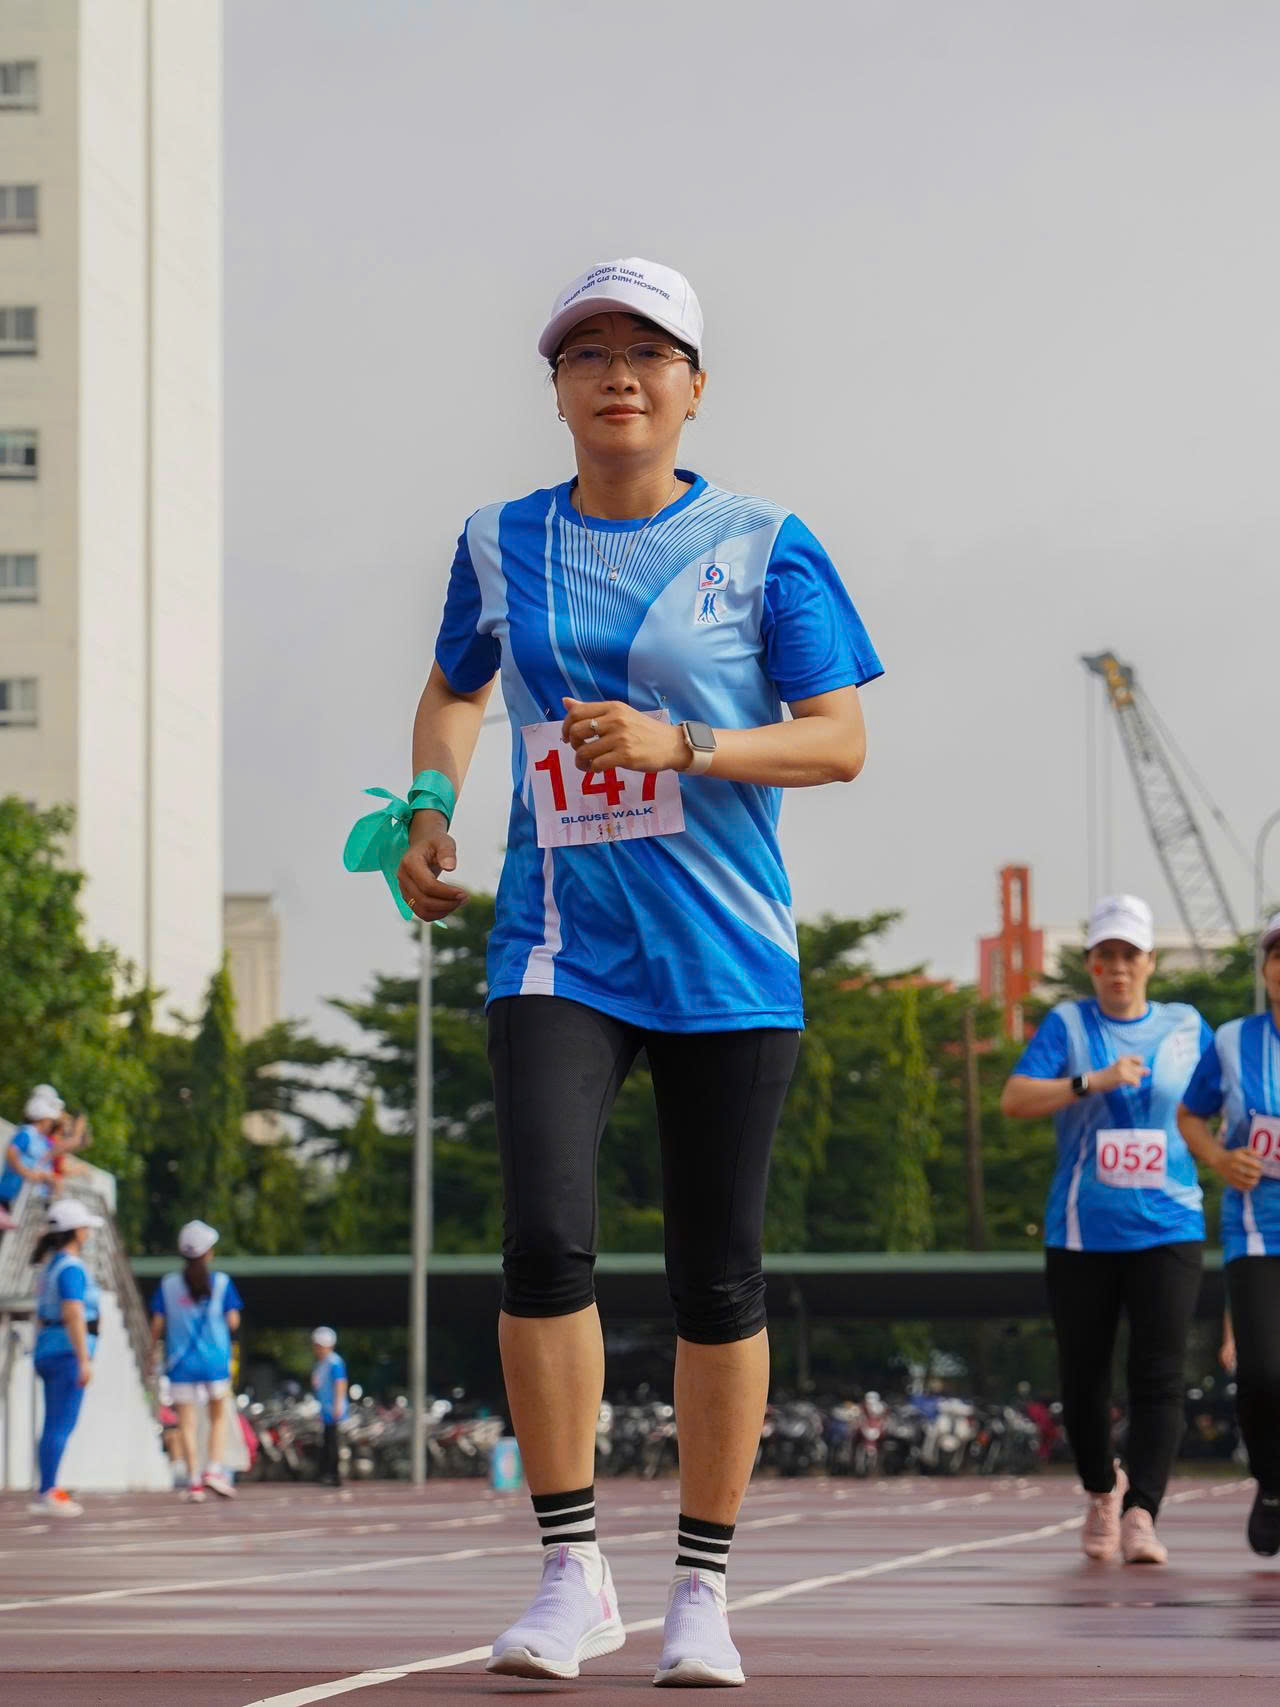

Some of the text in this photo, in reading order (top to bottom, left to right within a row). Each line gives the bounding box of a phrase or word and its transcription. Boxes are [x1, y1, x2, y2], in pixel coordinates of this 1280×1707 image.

[561, 806, 654, 825] BLOUSE WALK
[1101, 1143, 1163, 1172] 052
